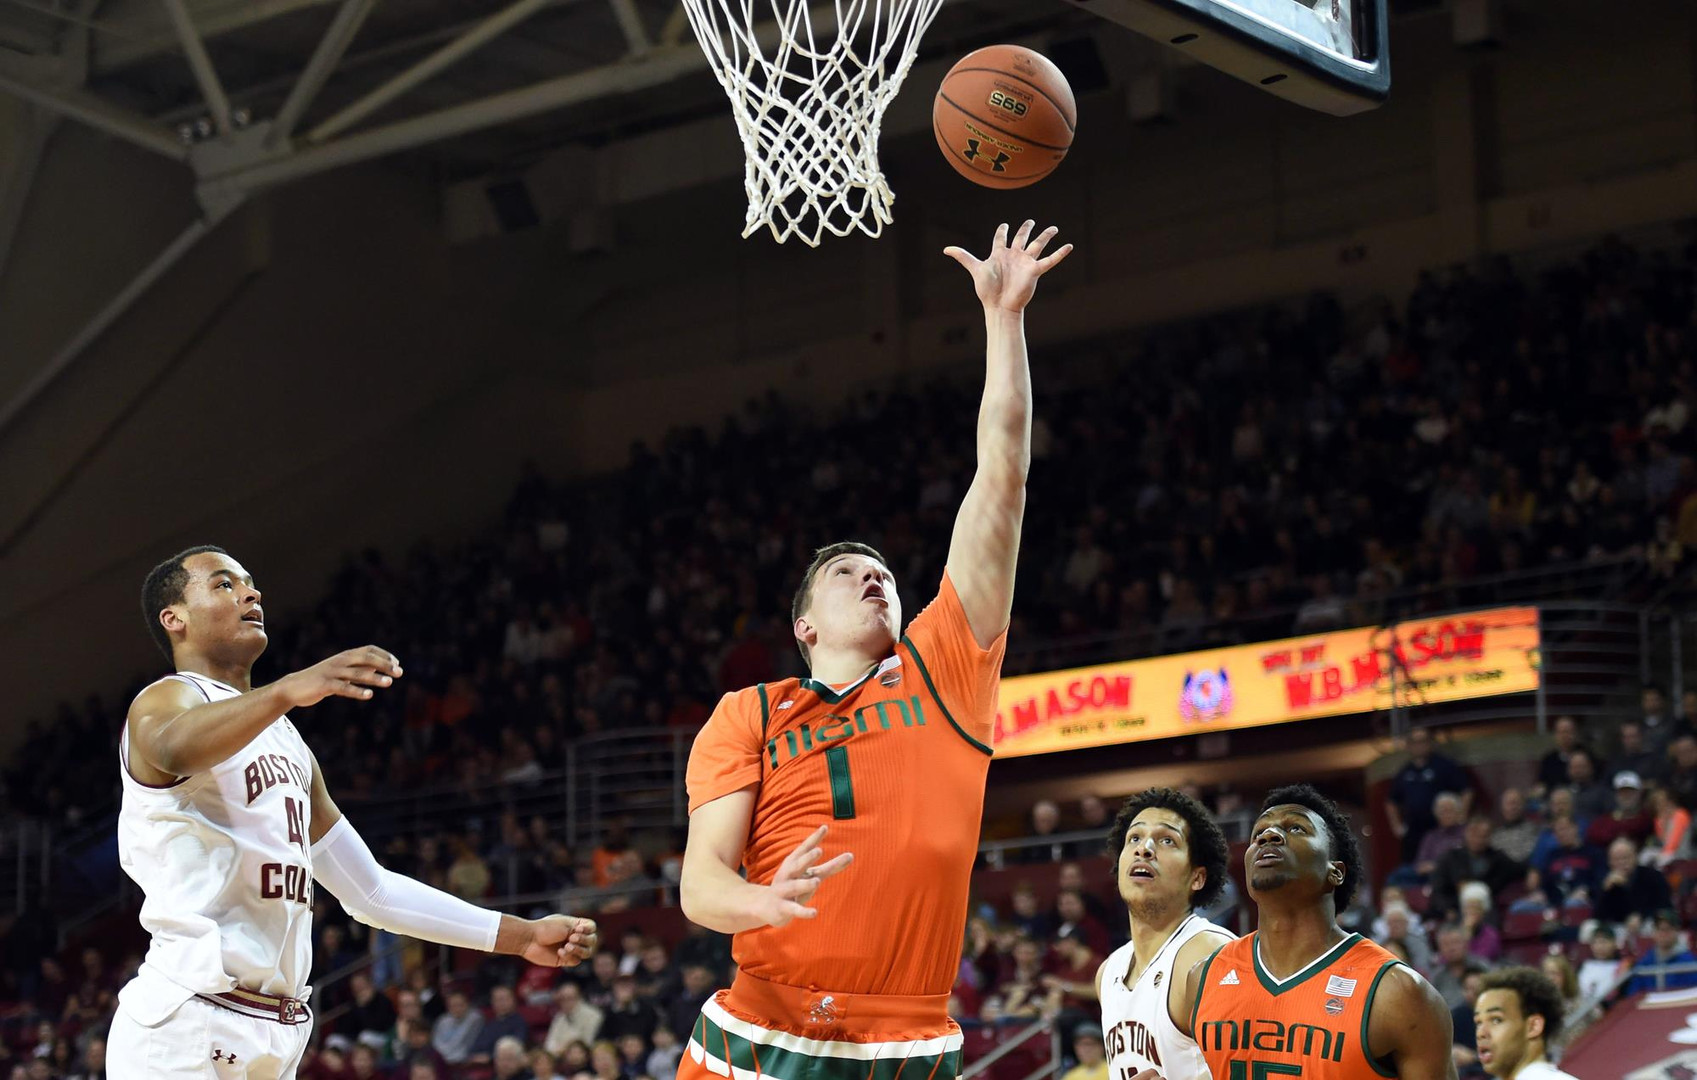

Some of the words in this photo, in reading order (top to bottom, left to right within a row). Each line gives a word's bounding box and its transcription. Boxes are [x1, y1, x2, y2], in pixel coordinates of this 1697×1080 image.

[989, 92, 1027, 116] 695
[245, 754, 310, 804] BOSTO
[825, 746, 856, 820] 1
